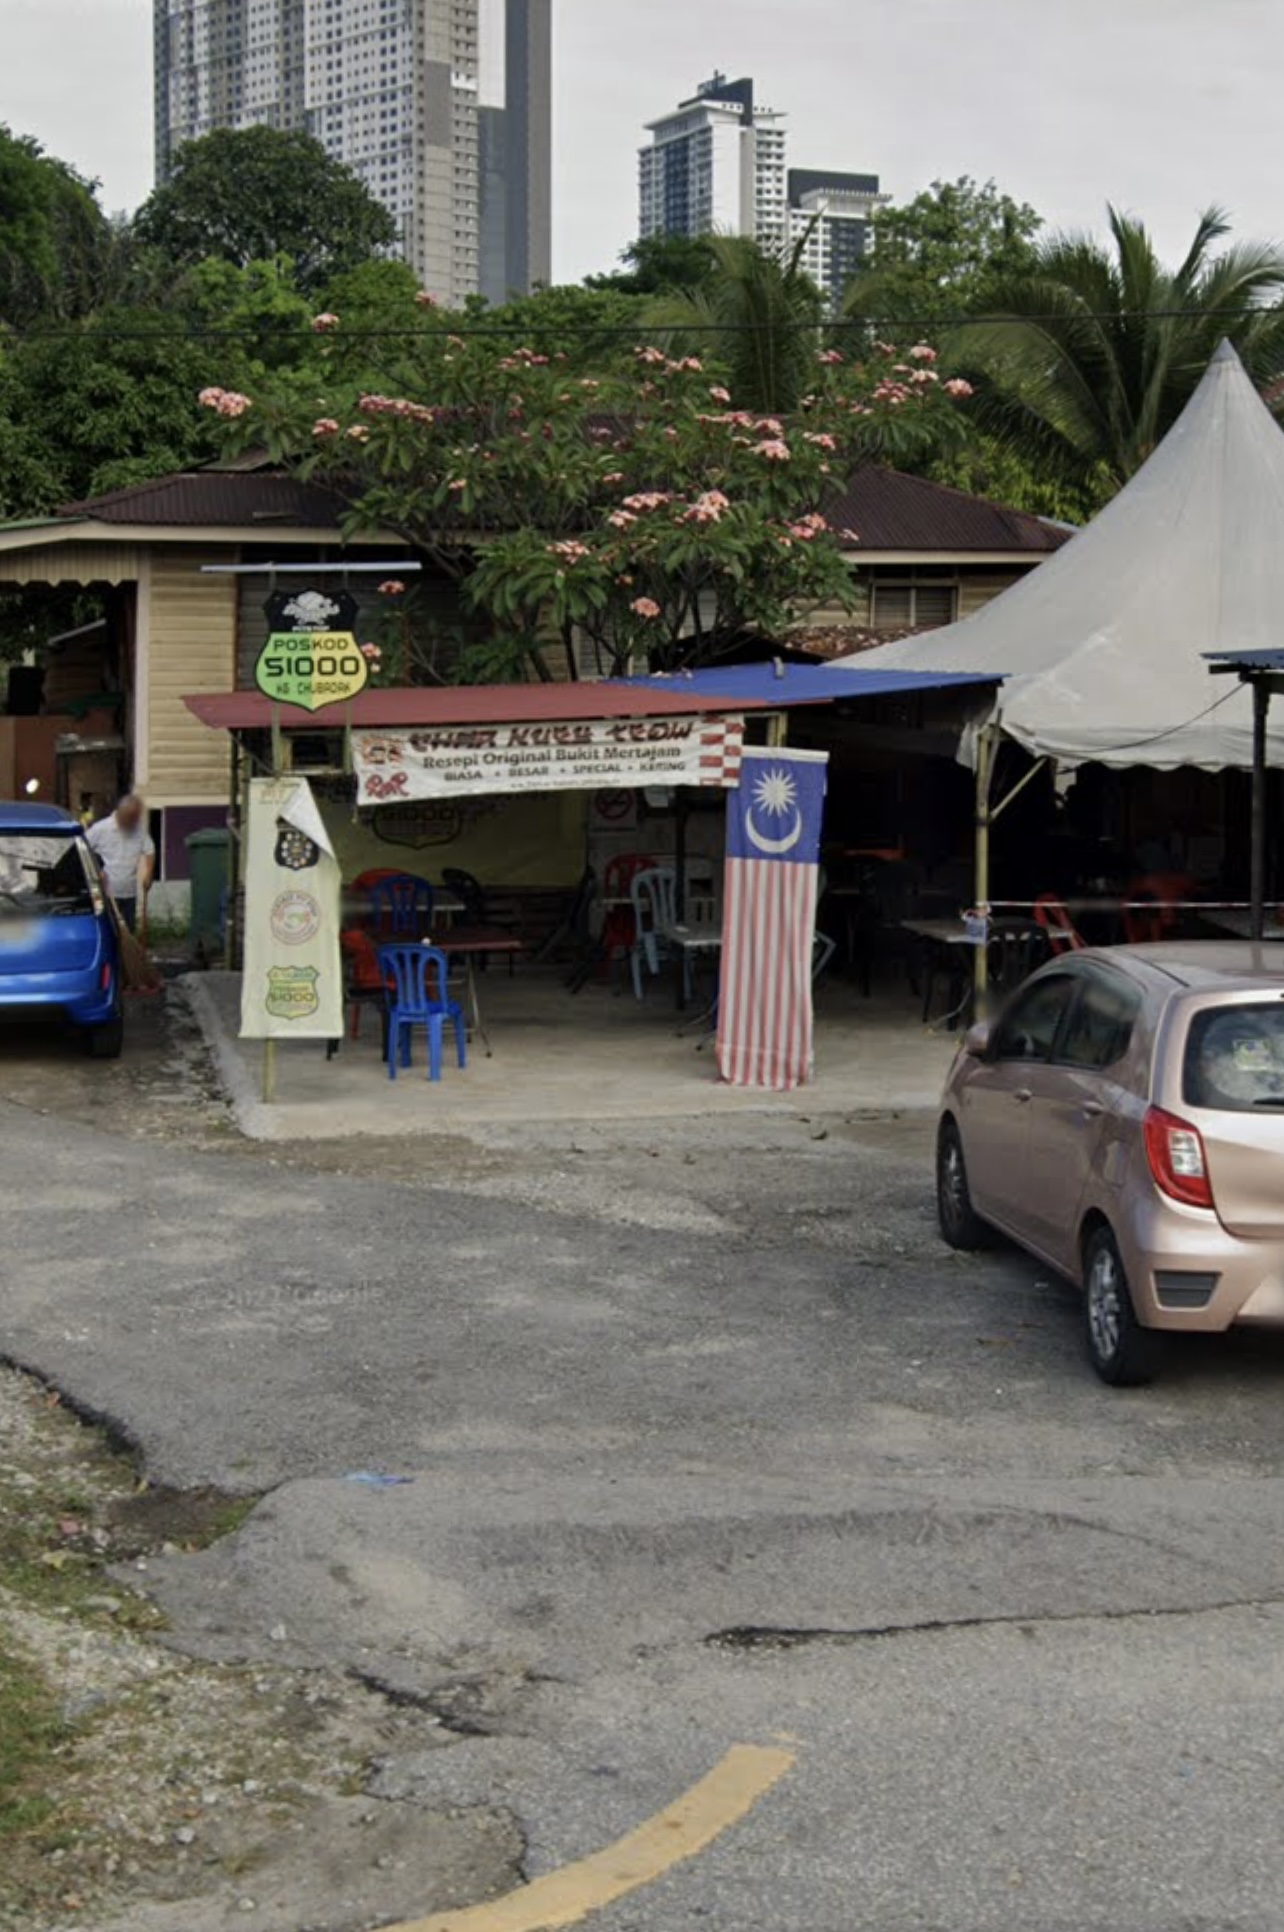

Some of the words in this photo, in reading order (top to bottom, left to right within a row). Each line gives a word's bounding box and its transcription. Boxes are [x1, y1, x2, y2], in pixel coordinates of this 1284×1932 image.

[273, 637, 349, 652] POSKOD
[264, 656, 360, 678] 51000
[423, 755, 479, 770] Resepi
[482, 746, 552, 766] Original
[555, 747, 599, 762] Bukit
[604, 743, 681, 763] Mertajam
[444, 769, 484, 782] BIASA
[507, 764, 550, 777] BESAR
[573, 761, 622, 774] SPECIAL
